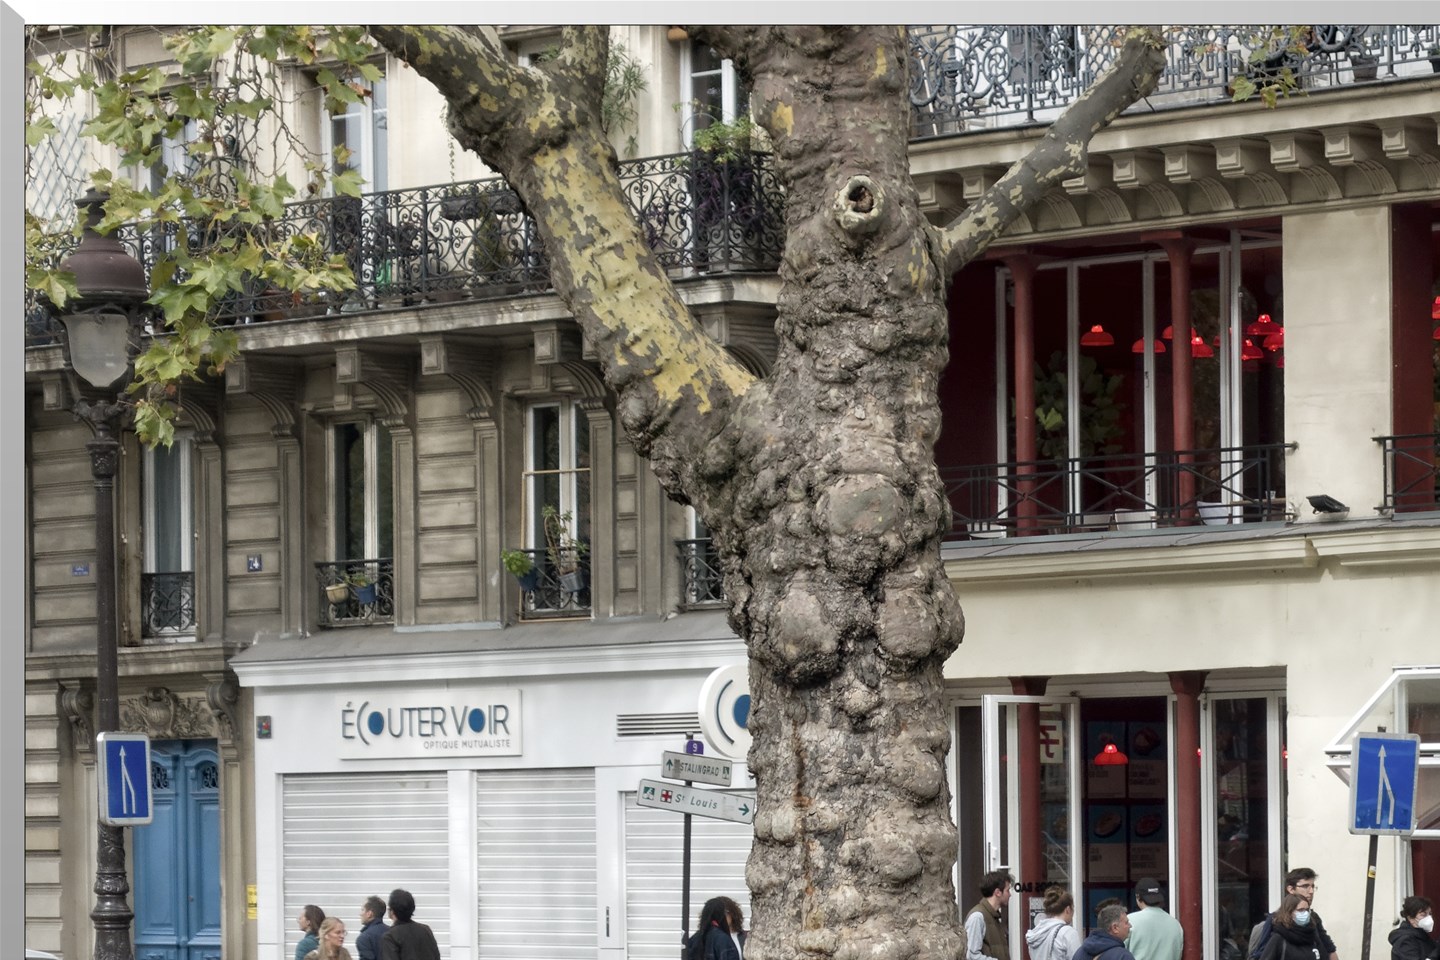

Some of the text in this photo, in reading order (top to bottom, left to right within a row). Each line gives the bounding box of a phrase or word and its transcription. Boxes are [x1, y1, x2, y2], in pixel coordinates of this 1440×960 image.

[247, 556, 259, 570] 74
[423, 739, 511, 750] OPTIQUE MUTUALISTE
[692, 743, 698, 752] 9
[680, 762, 720, 777] STALINGRAD
[690, 796, 718, 810] Louis
